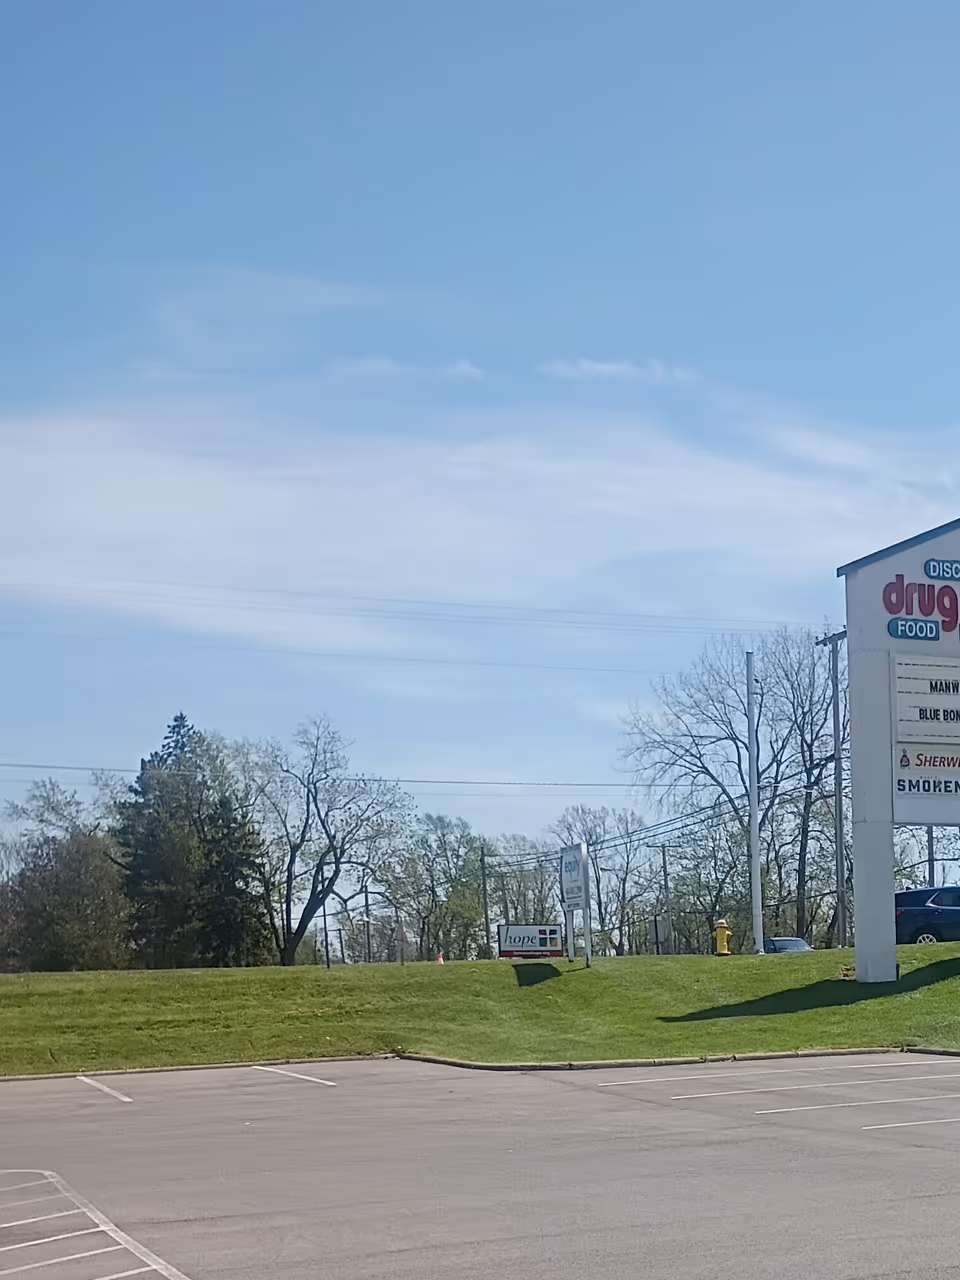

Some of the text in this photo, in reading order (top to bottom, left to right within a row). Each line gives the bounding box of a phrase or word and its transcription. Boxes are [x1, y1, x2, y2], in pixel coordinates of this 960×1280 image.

[882, 574, 959, 632] drug
[897, 620, 936, 638] FOOD
[919, 708, 941, 721] BLUE
[504, 926, 537, 948] hope
